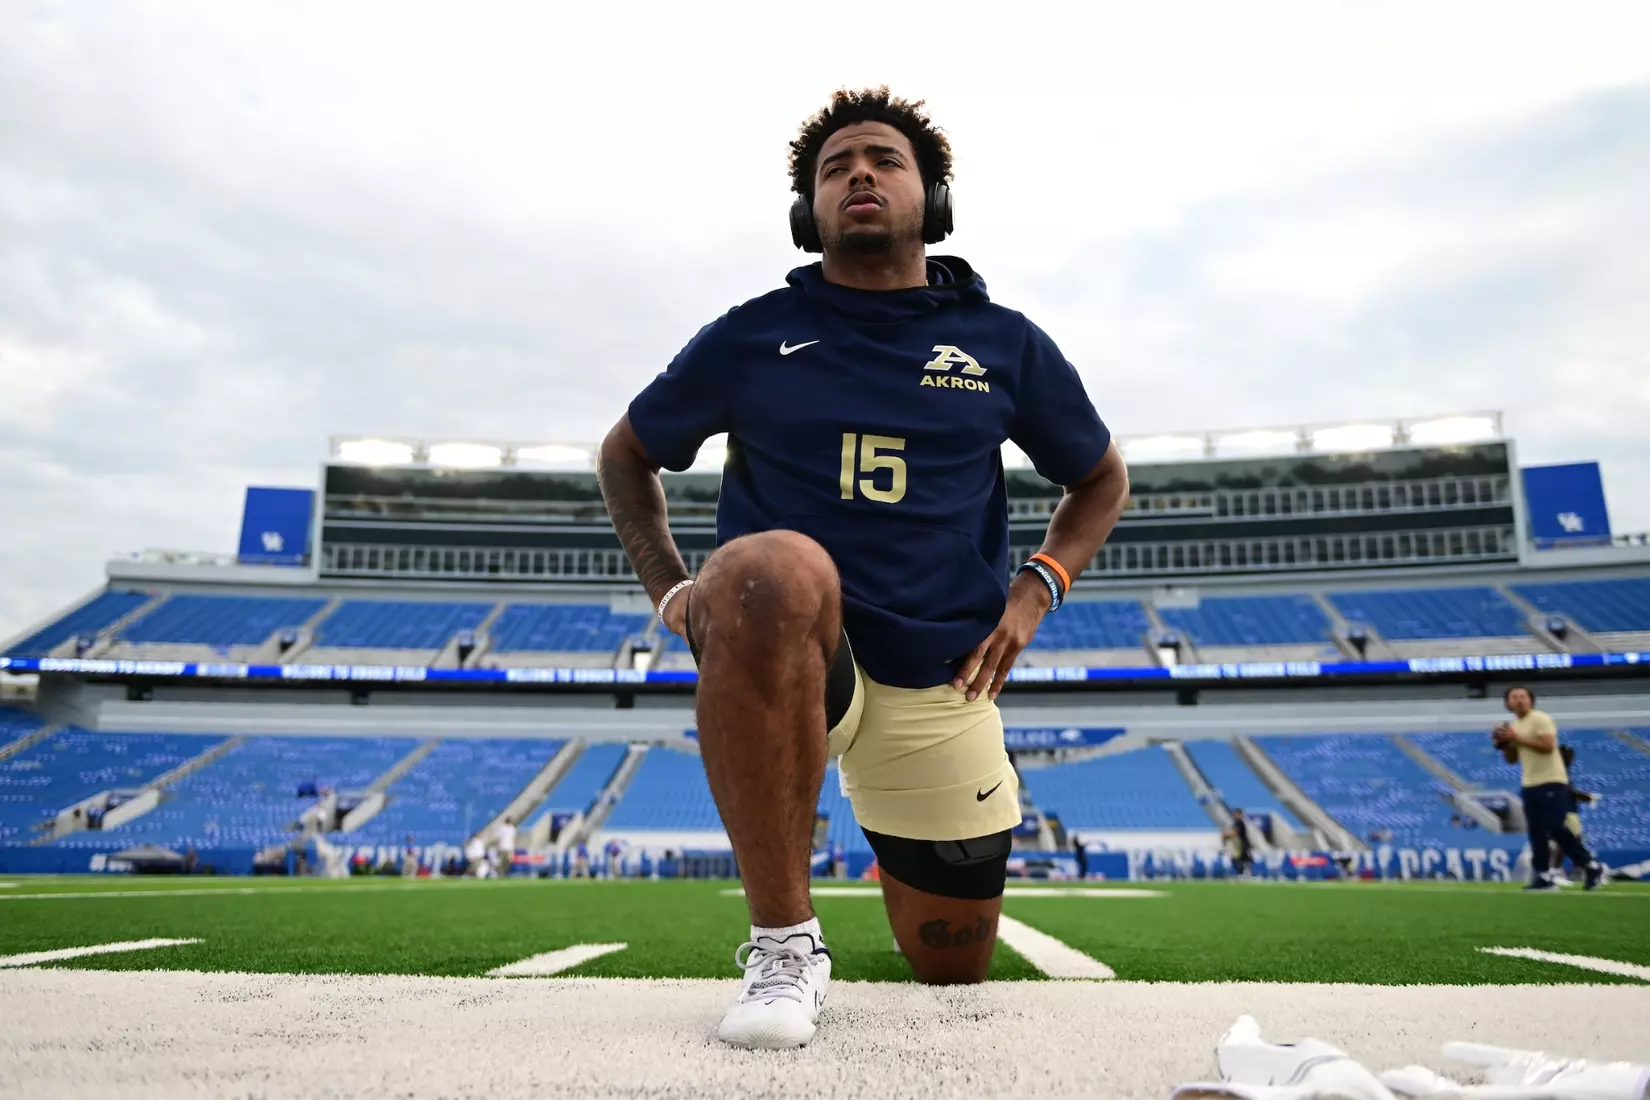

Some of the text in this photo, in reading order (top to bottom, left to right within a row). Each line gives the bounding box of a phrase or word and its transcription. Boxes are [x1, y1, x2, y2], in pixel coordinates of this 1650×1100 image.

[923, 344, 988, 377] A
[920, 374, 990, 393] AKRON
[839, 432, 907, 504] 15
